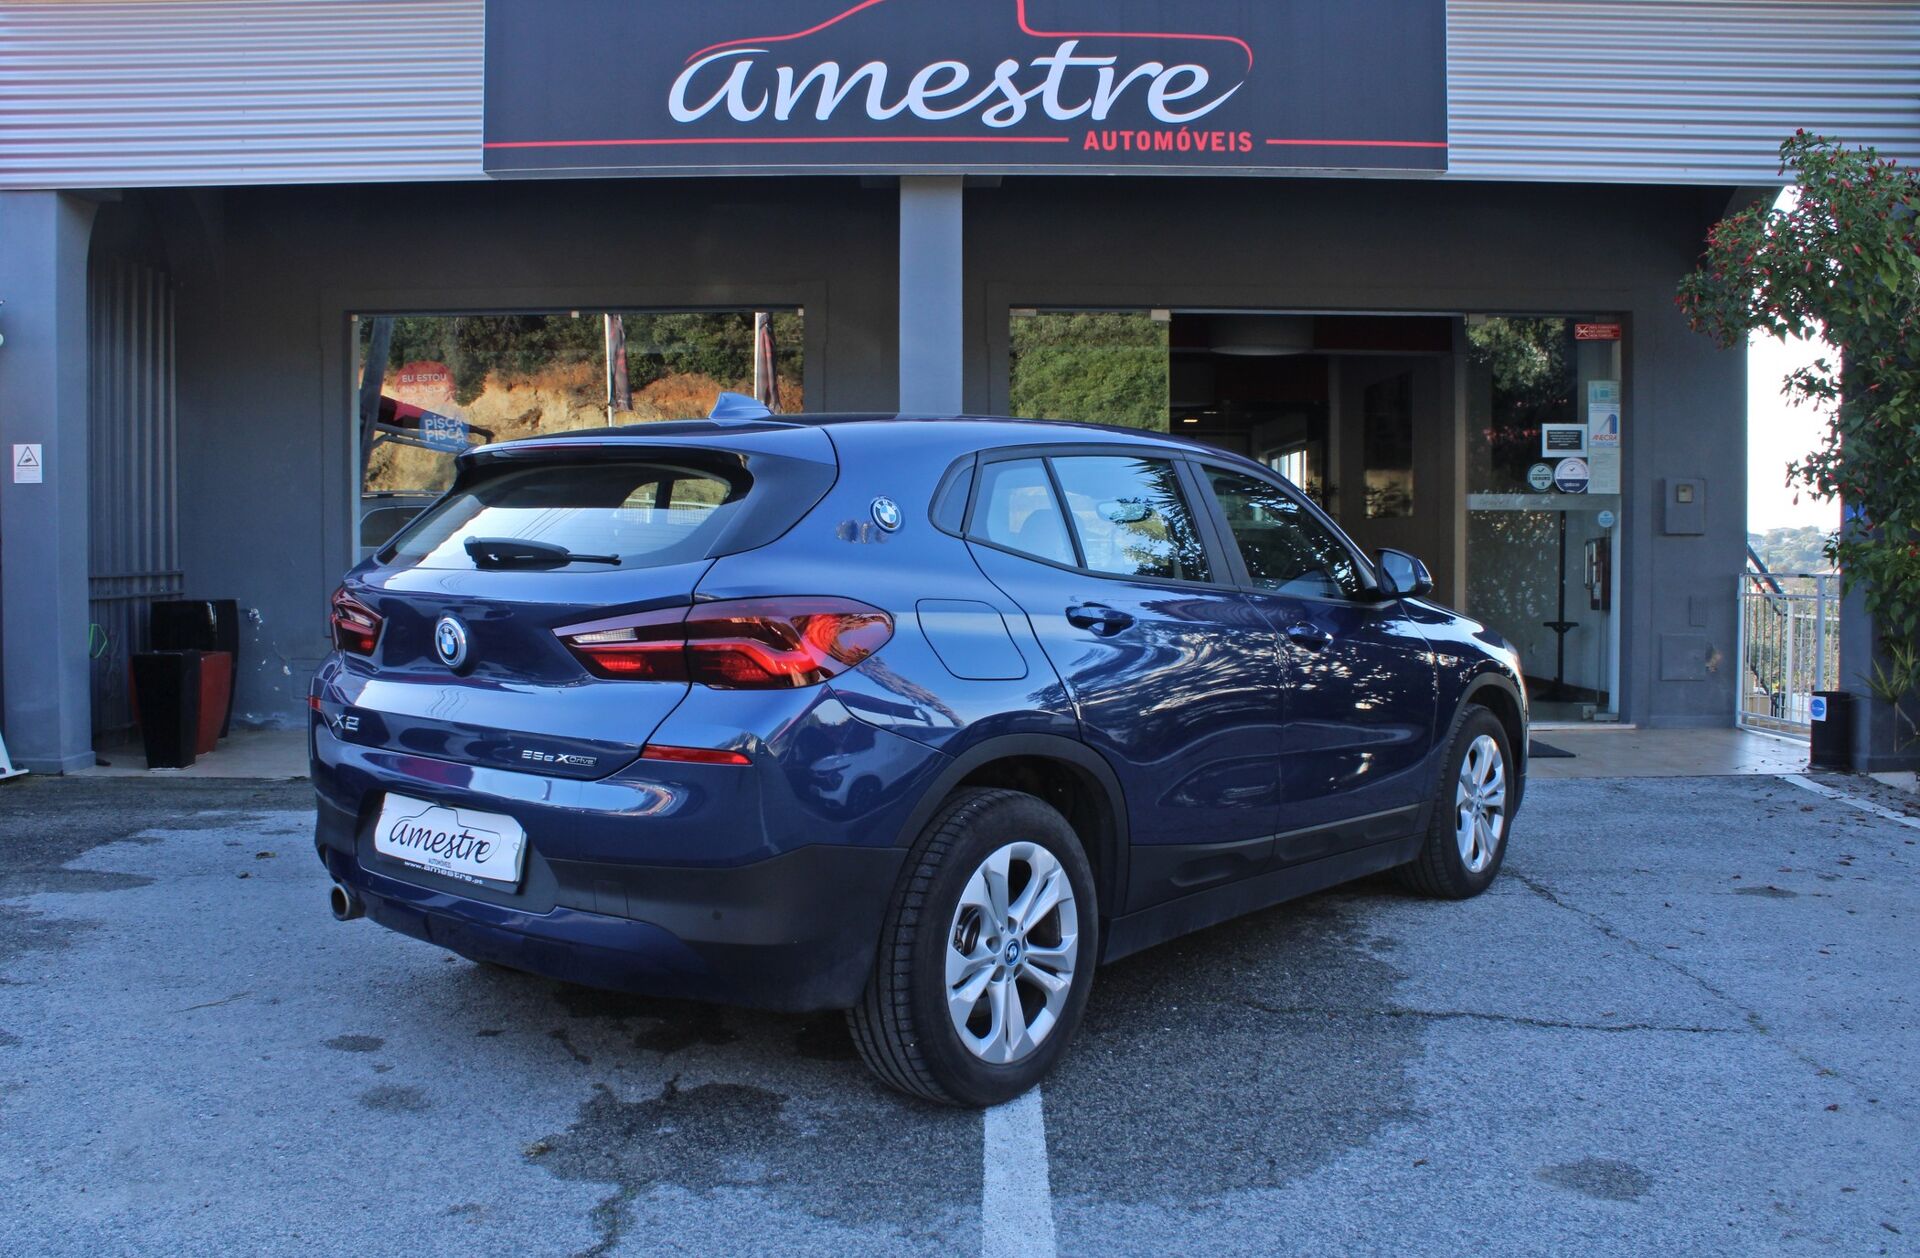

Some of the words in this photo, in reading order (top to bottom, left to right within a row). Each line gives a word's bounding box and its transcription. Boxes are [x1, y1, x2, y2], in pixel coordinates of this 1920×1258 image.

[668, 40, 1244, 128] amestre
[1083, 126, 1253, 152] AUTOMÓVEIS
[402, 374, 414, 383] EU
[416, 373, 447, 382] ESTOU
[331, 713, 360, 731] X2
[389, 818, 499, 864] amestre
[404, 860, 484, 885] www.amestre.pt
